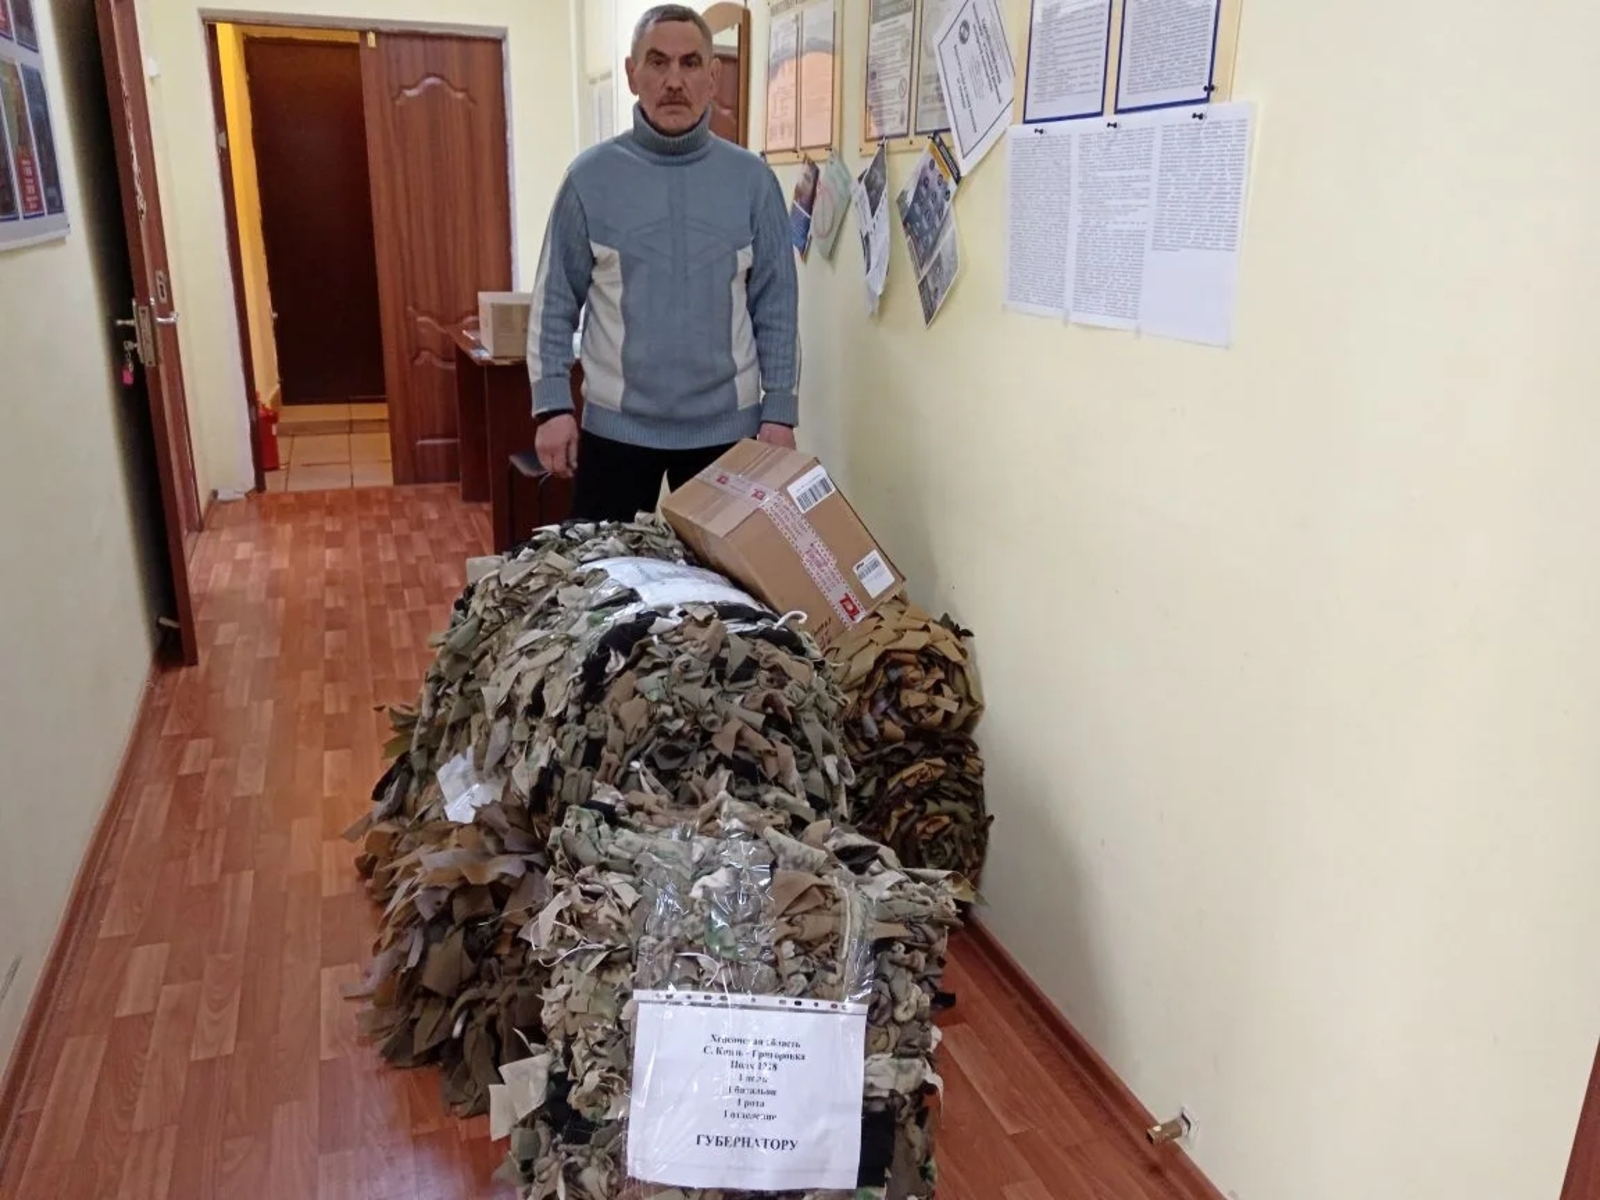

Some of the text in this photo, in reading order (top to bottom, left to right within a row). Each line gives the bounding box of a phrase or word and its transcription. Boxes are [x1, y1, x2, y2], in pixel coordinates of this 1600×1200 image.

[710, 1034, 763, 1046] Херсонсая
[734, 1085, 777, 1096] баальон
[743, 1101, 765, 1109] рота
[696, 1134, 799, 1151] ГУБЕРНАТОРУ
